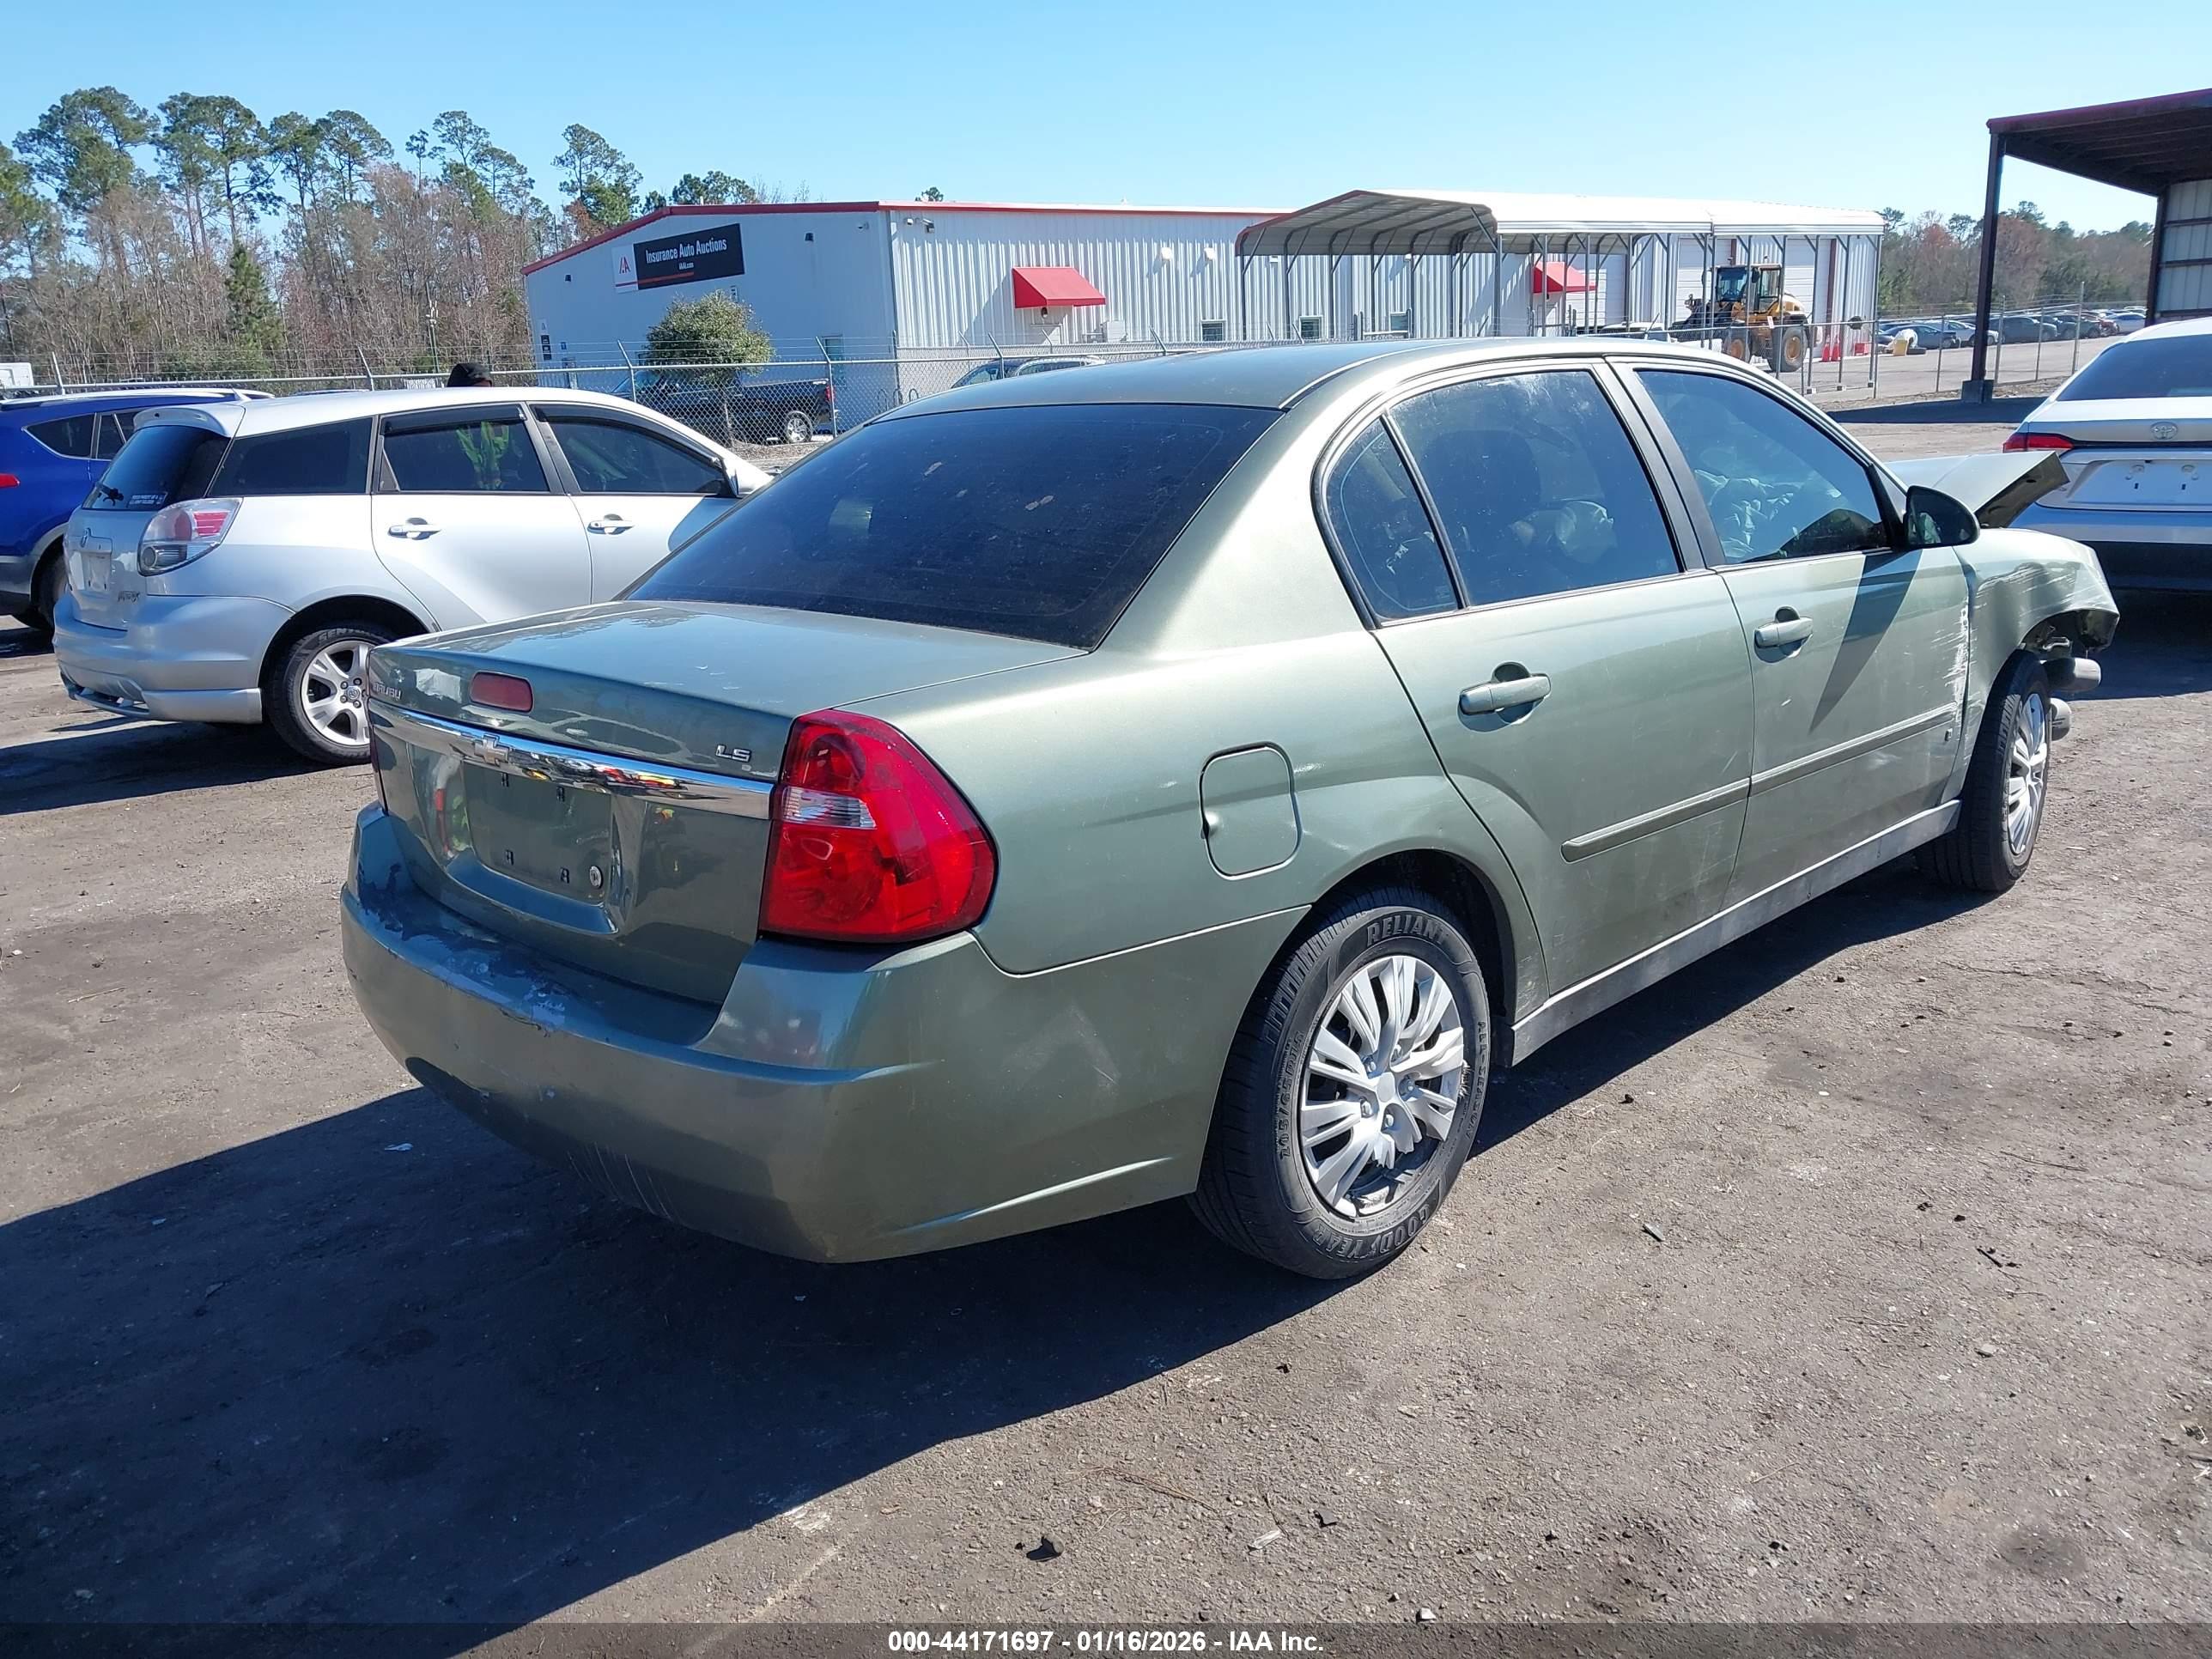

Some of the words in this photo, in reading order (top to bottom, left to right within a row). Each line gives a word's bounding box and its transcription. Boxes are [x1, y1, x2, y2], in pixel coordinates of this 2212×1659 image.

[646, 248, 678, 264] Insurance
[679, 243, 695, 258] Auto
[696, 237, 727, 255] Auctions
[715, 744, 751, 763] LS
[1367, 915, 1444, 947] RELIANT
